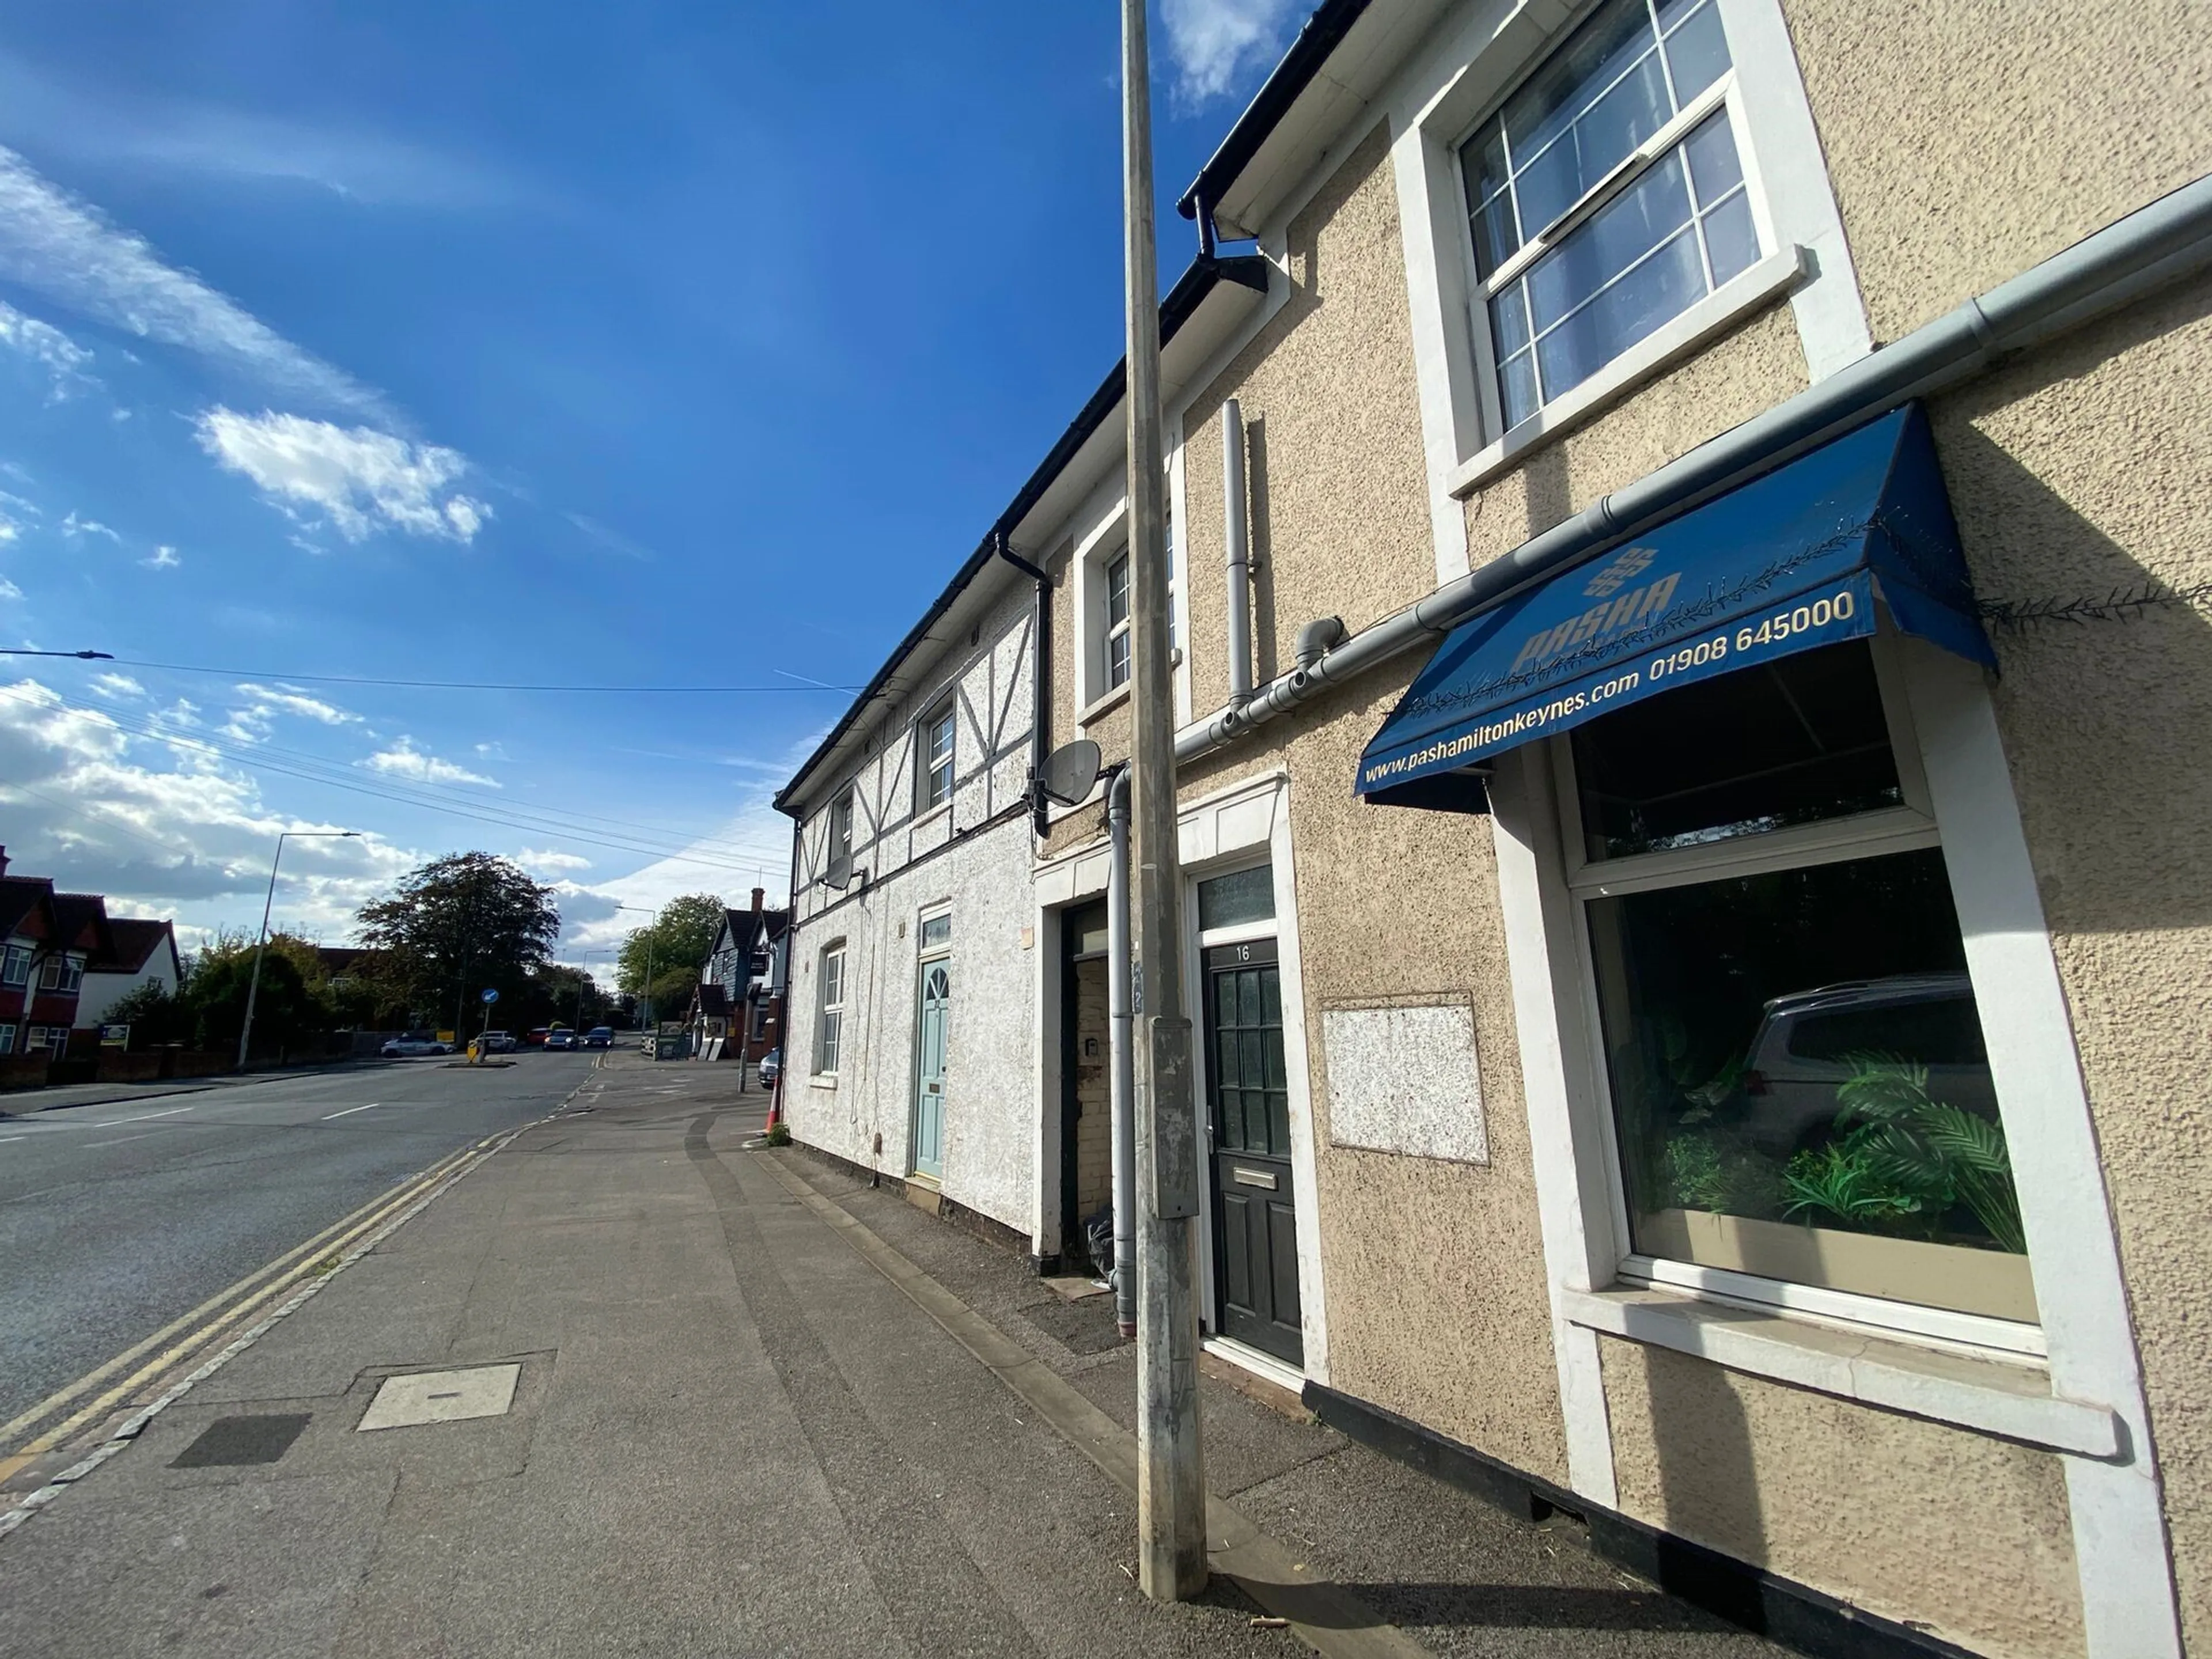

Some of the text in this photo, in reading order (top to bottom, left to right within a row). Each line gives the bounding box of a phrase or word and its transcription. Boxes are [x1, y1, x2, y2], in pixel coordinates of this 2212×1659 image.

[1510, 572, 1683, 675] PASHA
[1365, 670, 1639, 783] www.pashamiltonkeynes.com
[1649, 636, 1728, 681] 01908
[1736, 591, 1855, 652] 645000
[1236, 945, 1249, 961] 16
